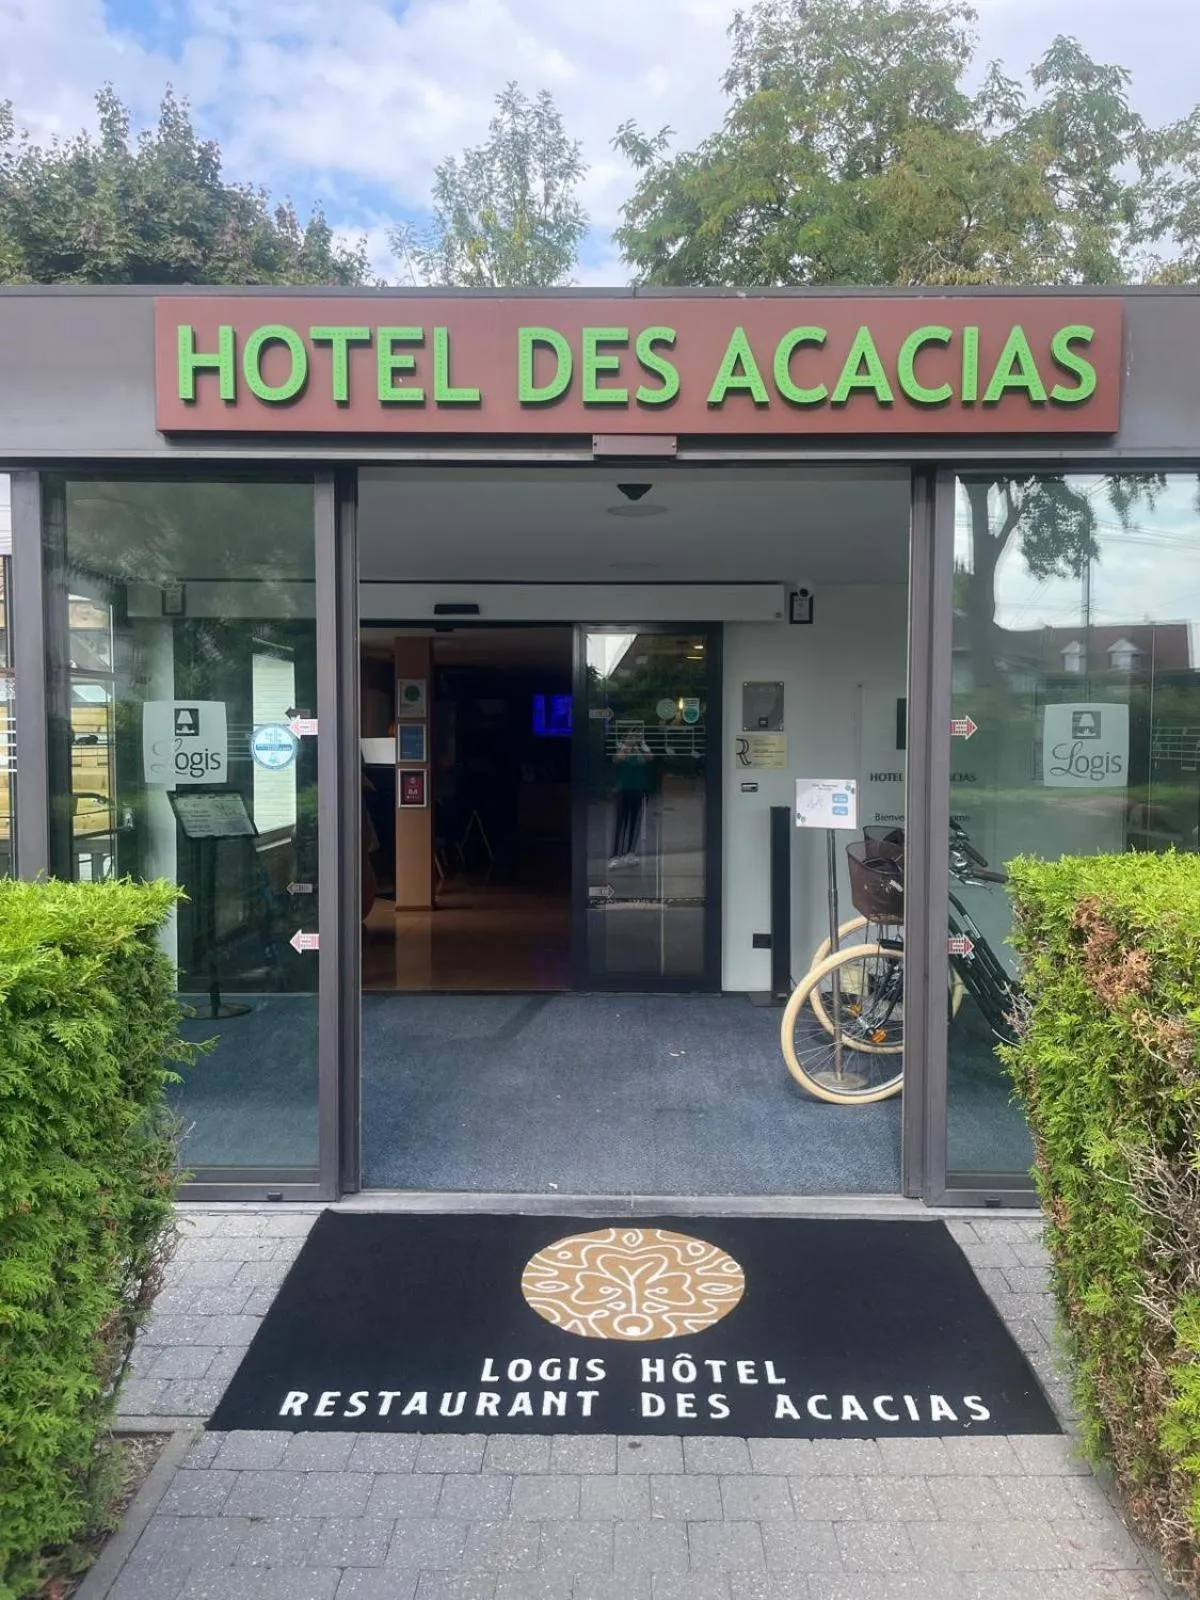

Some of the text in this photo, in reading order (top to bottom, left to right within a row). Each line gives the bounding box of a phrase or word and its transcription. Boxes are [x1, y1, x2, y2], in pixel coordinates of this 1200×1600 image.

[177, 325, 1097, 404] HOTEL DES ACACIAS
[1049, 741, 1122, 781] Logis
[870, 772, 904, 782] HOTEL
[480, 1353, 786, 1384] LOGIS HÔTEL
[279, 1390, 991, 1421] RESTAURANT DES ACACIAS
